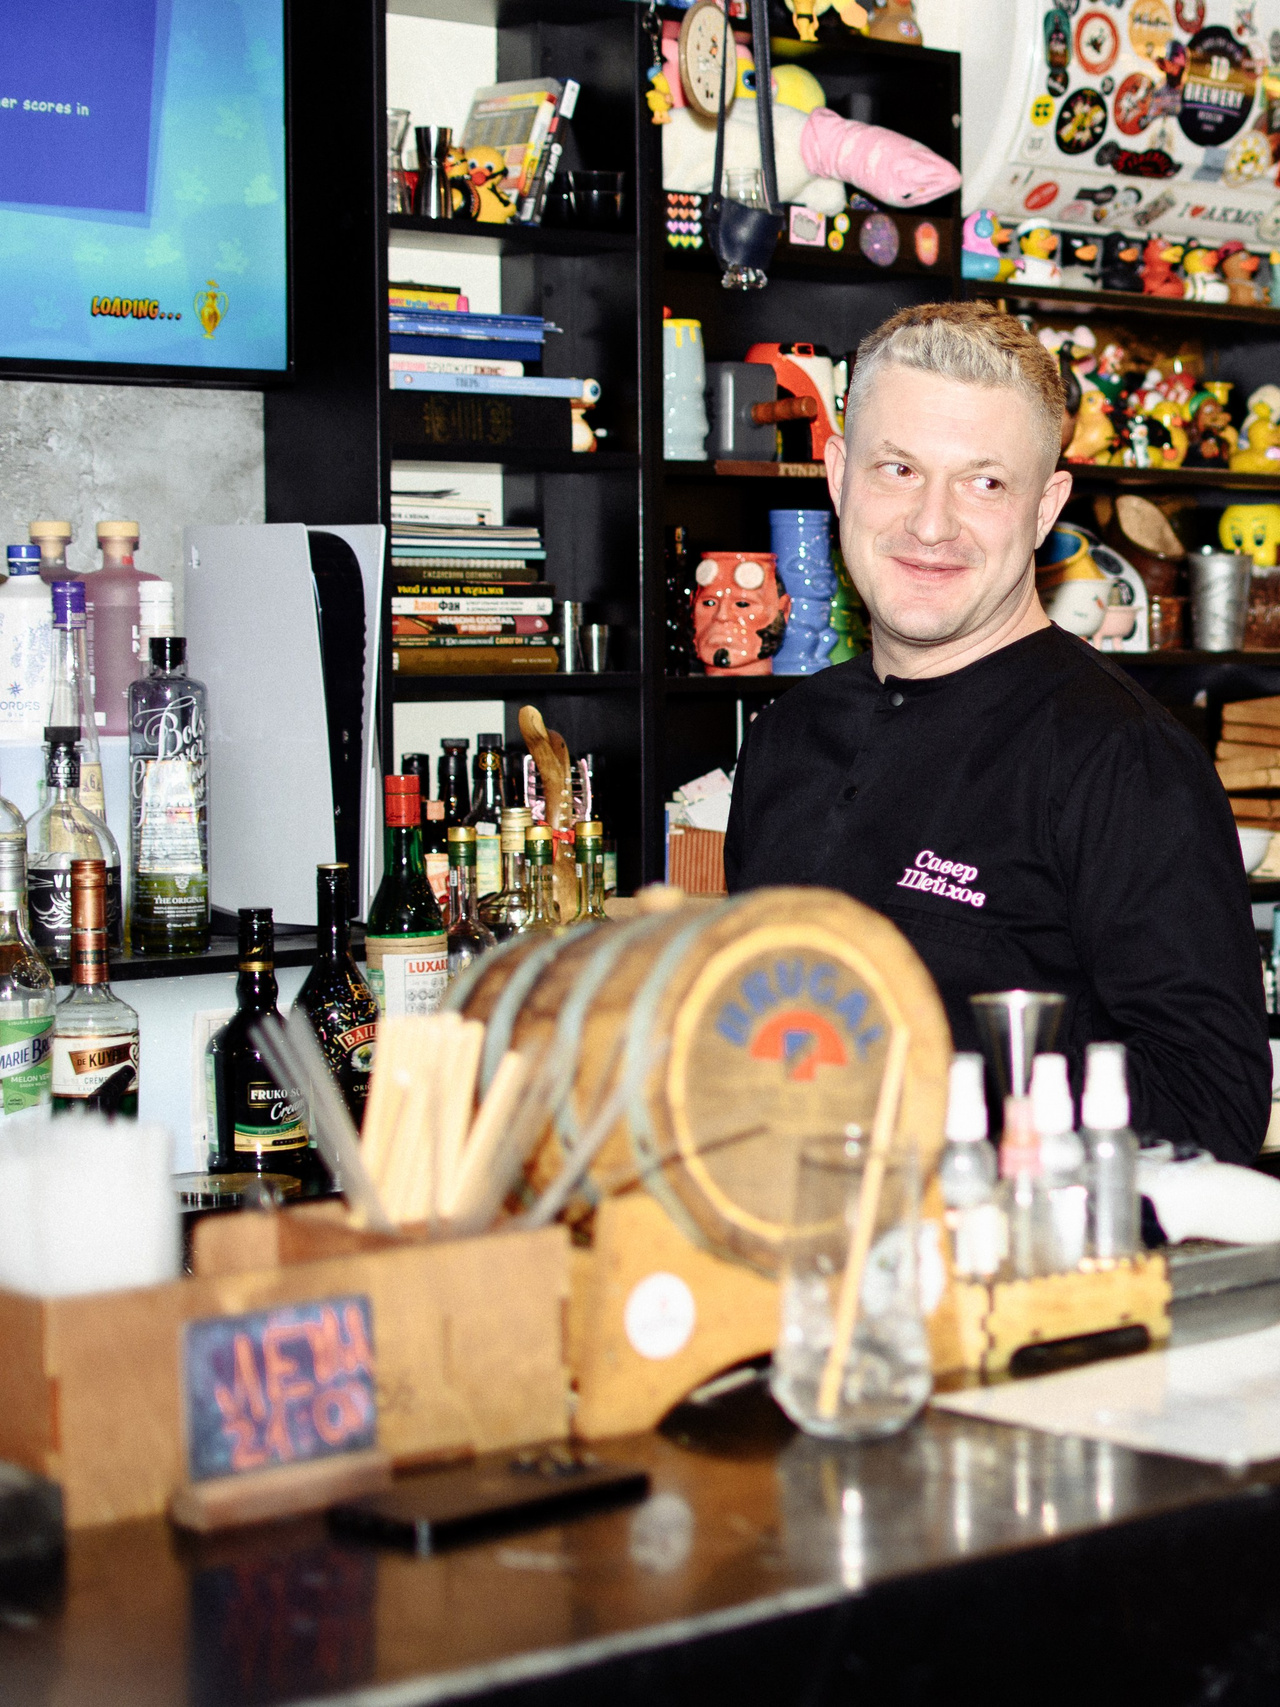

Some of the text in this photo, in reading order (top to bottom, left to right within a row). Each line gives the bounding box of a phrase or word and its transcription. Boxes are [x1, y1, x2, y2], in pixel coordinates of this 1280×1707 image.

[23, 99, 72, 115] scores
[76, 102, 90, 116] in
[91, 296, 181, 320] LOADING...
[914, 849, 979, 885] Савер
[896, 868, 987, 908] Шейхов
[153, 895, 205, 905] THE ORIGINAL
[76, 1058, 87, 1067] DE
[10, 1074, 37, 1084] MELON
[250, 1088, 288, 1101] FRUKO
